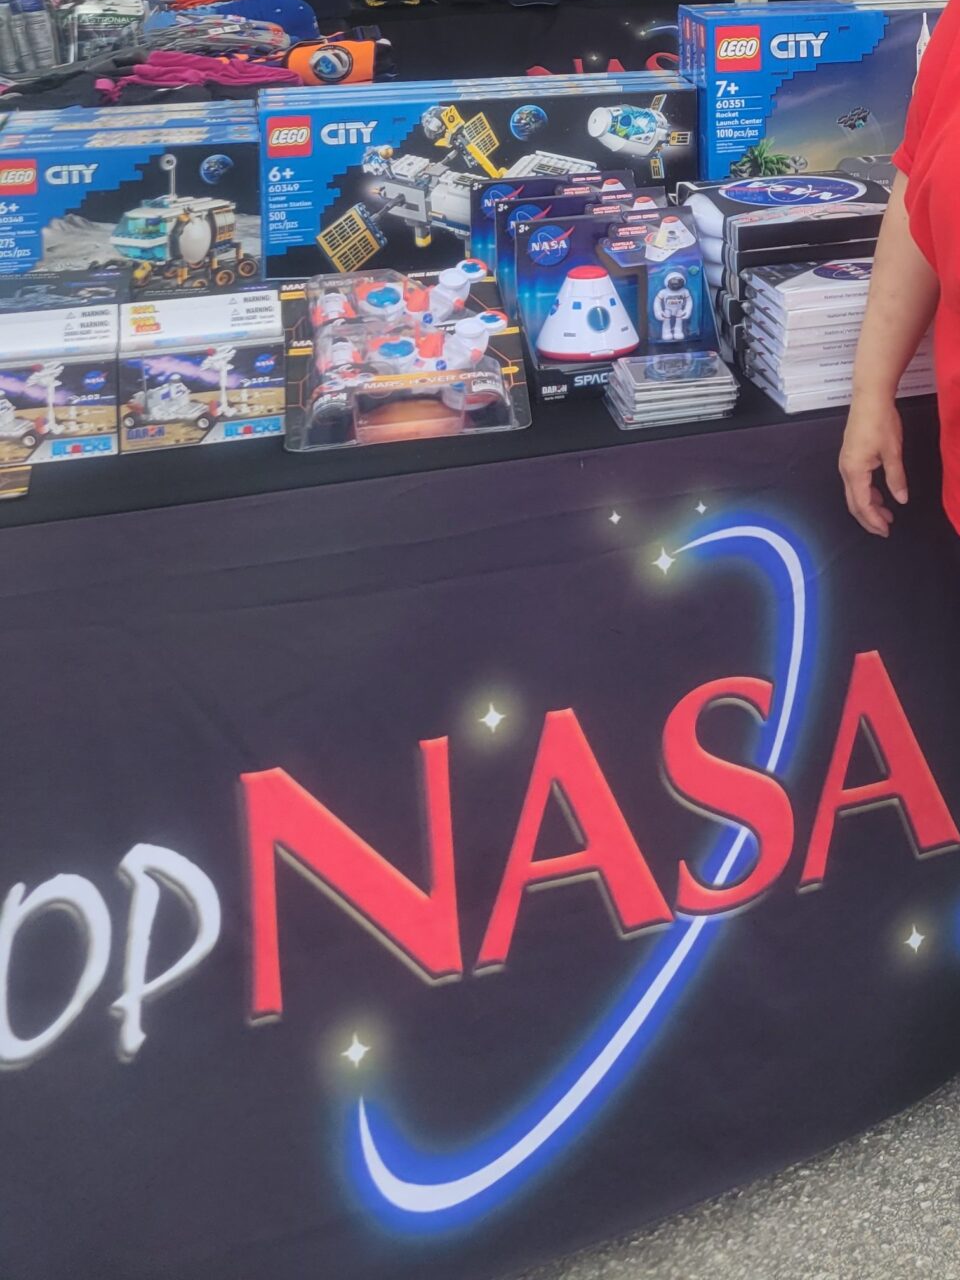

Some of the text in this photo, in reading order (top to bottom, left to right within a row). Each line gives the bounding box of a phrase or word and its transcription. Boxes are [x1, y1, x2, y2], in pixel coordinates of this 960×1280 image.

[718, 31, 830, 60] LEGO CITY
[715, 80, 740, 98] 7+
[715, 100, 746, 109] 60351
[715, 111, 740, 119] Rocket
[715, 119, 740, 127] Launch
[269, 120, 378, 146] LEGO CITY
[716, 128, 733, 139] 1010
[0, 163, 99, 186] LEGO CITY
[268, 166, 295, 182] 6+
[268, 183, 300, 194] 60349
[472, 182, 483, 191] 3+
[289, 200, 313, 208] Station
[498, 203, 509, 212] 3+
[518, 224, 530, 233] 3+
[531, 240, 568, 252] NASA
[574, 372, 609, 387] SPAC
